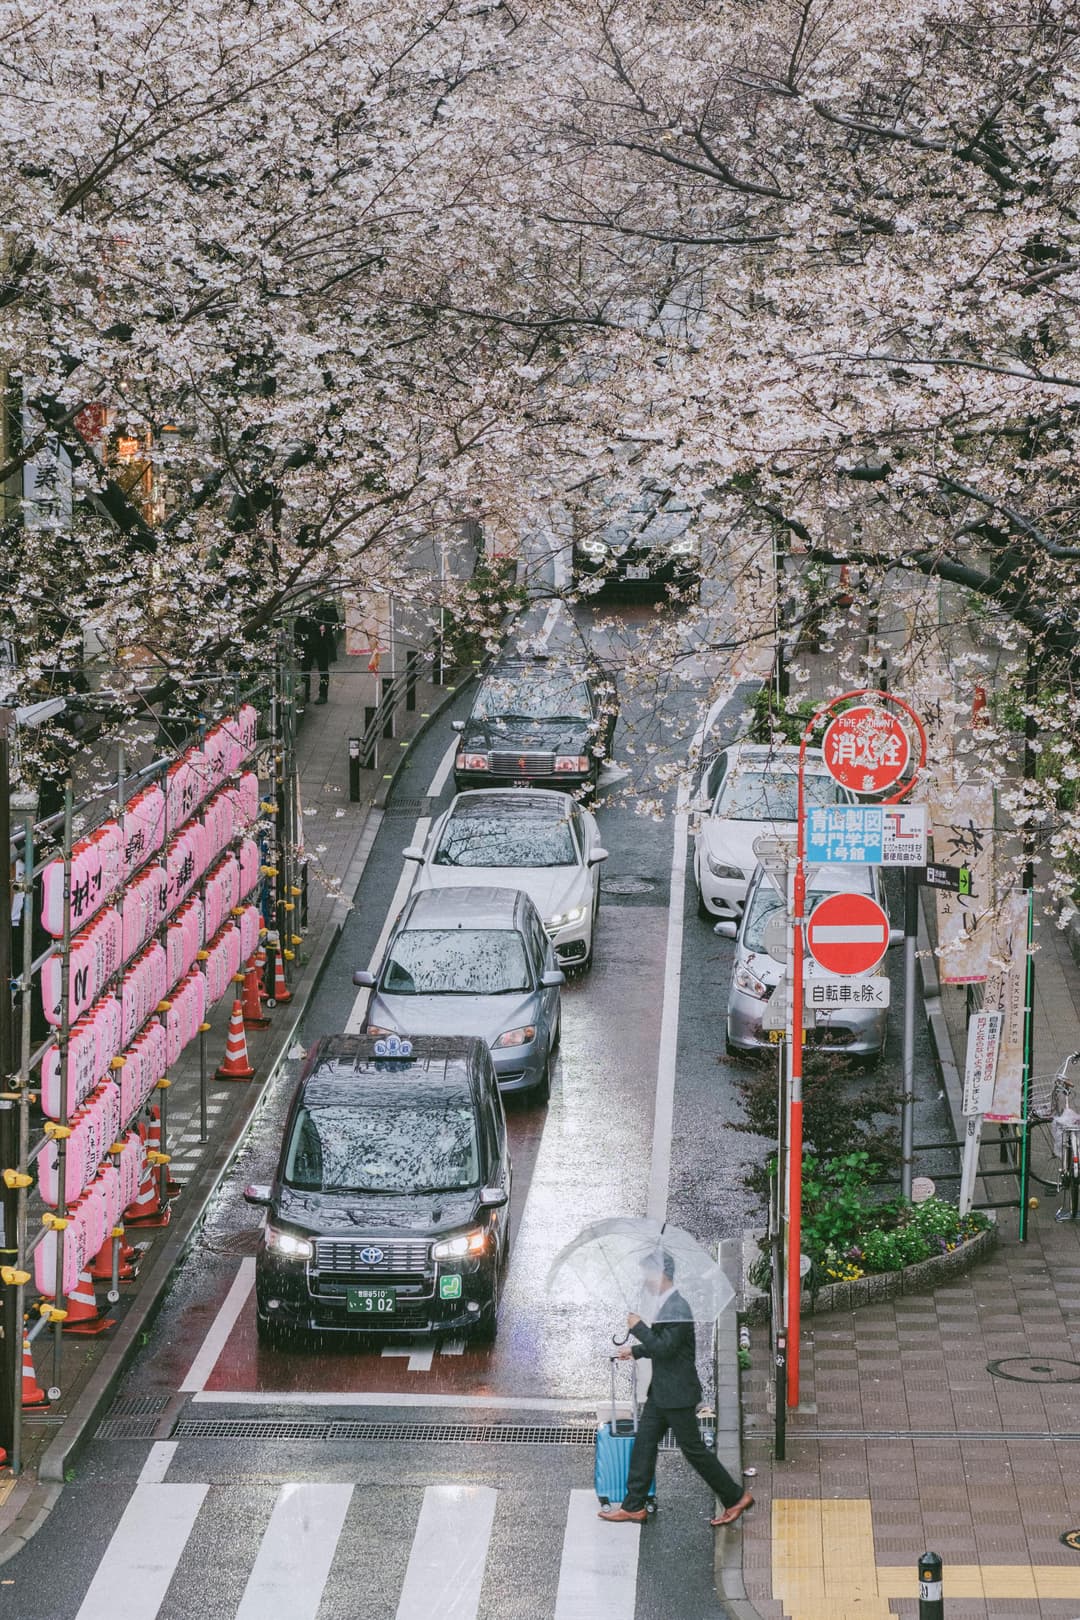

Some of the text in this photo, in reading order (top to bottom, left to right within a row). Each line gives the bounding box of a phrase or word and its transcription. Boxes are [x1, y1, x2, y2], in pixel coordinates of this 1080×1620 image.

[831, 731, 902, 766] 消火栓
[810, 831, 881, 847] 専門学校
[825, 847, 866, 861] 1号館
[813, 984, 883, 1002] 自転車を除く
